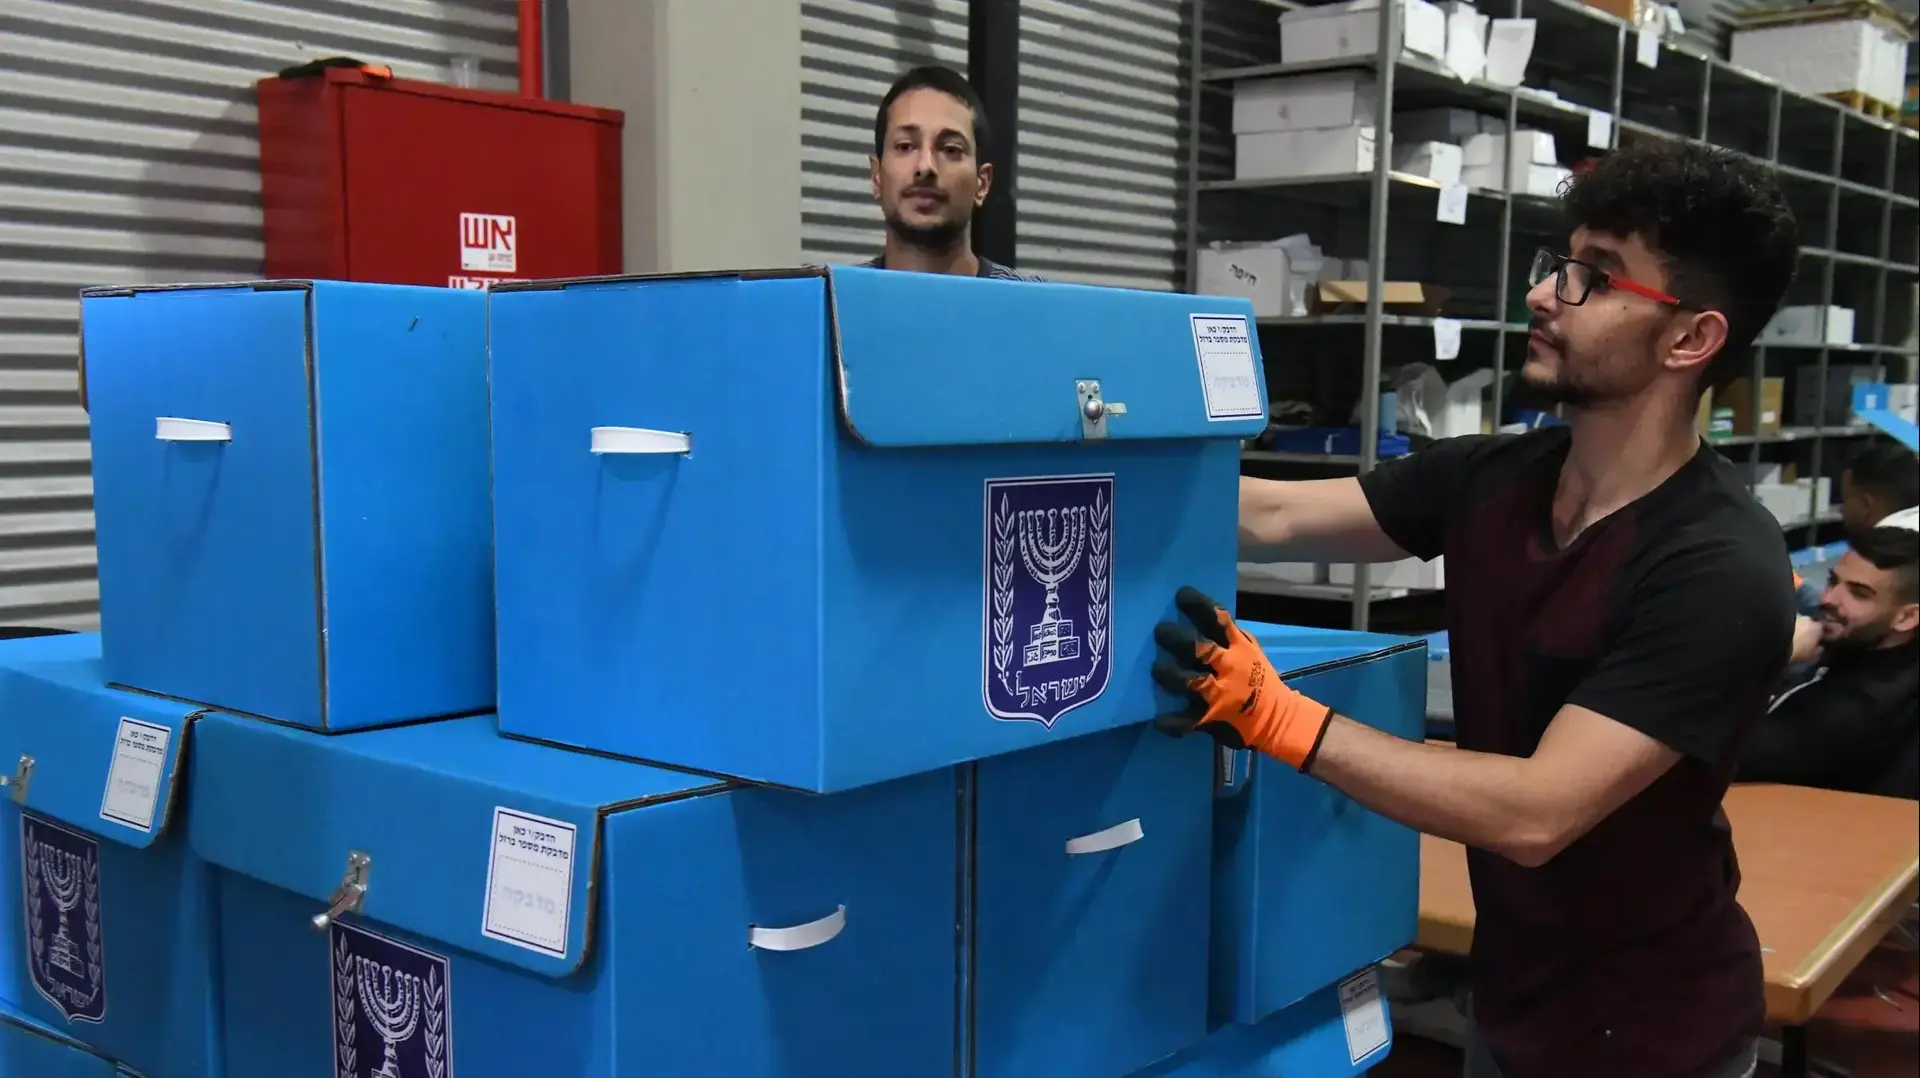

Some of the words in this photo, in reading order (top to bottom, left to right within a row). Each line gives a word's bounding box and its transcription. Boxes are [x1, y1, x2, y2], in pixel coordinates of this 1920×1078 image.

[464, 216, 512, 251] אש
[1015, 670, 1086, 708] ישראל
[513, 825, 526, 836] כאן
[528, 829, 556, 844] הדבק/י
[499, 833, 516, 846] ברזל
[518, 839, 539, 852] מספר
[540, 845, 569, 859] מדבקת
